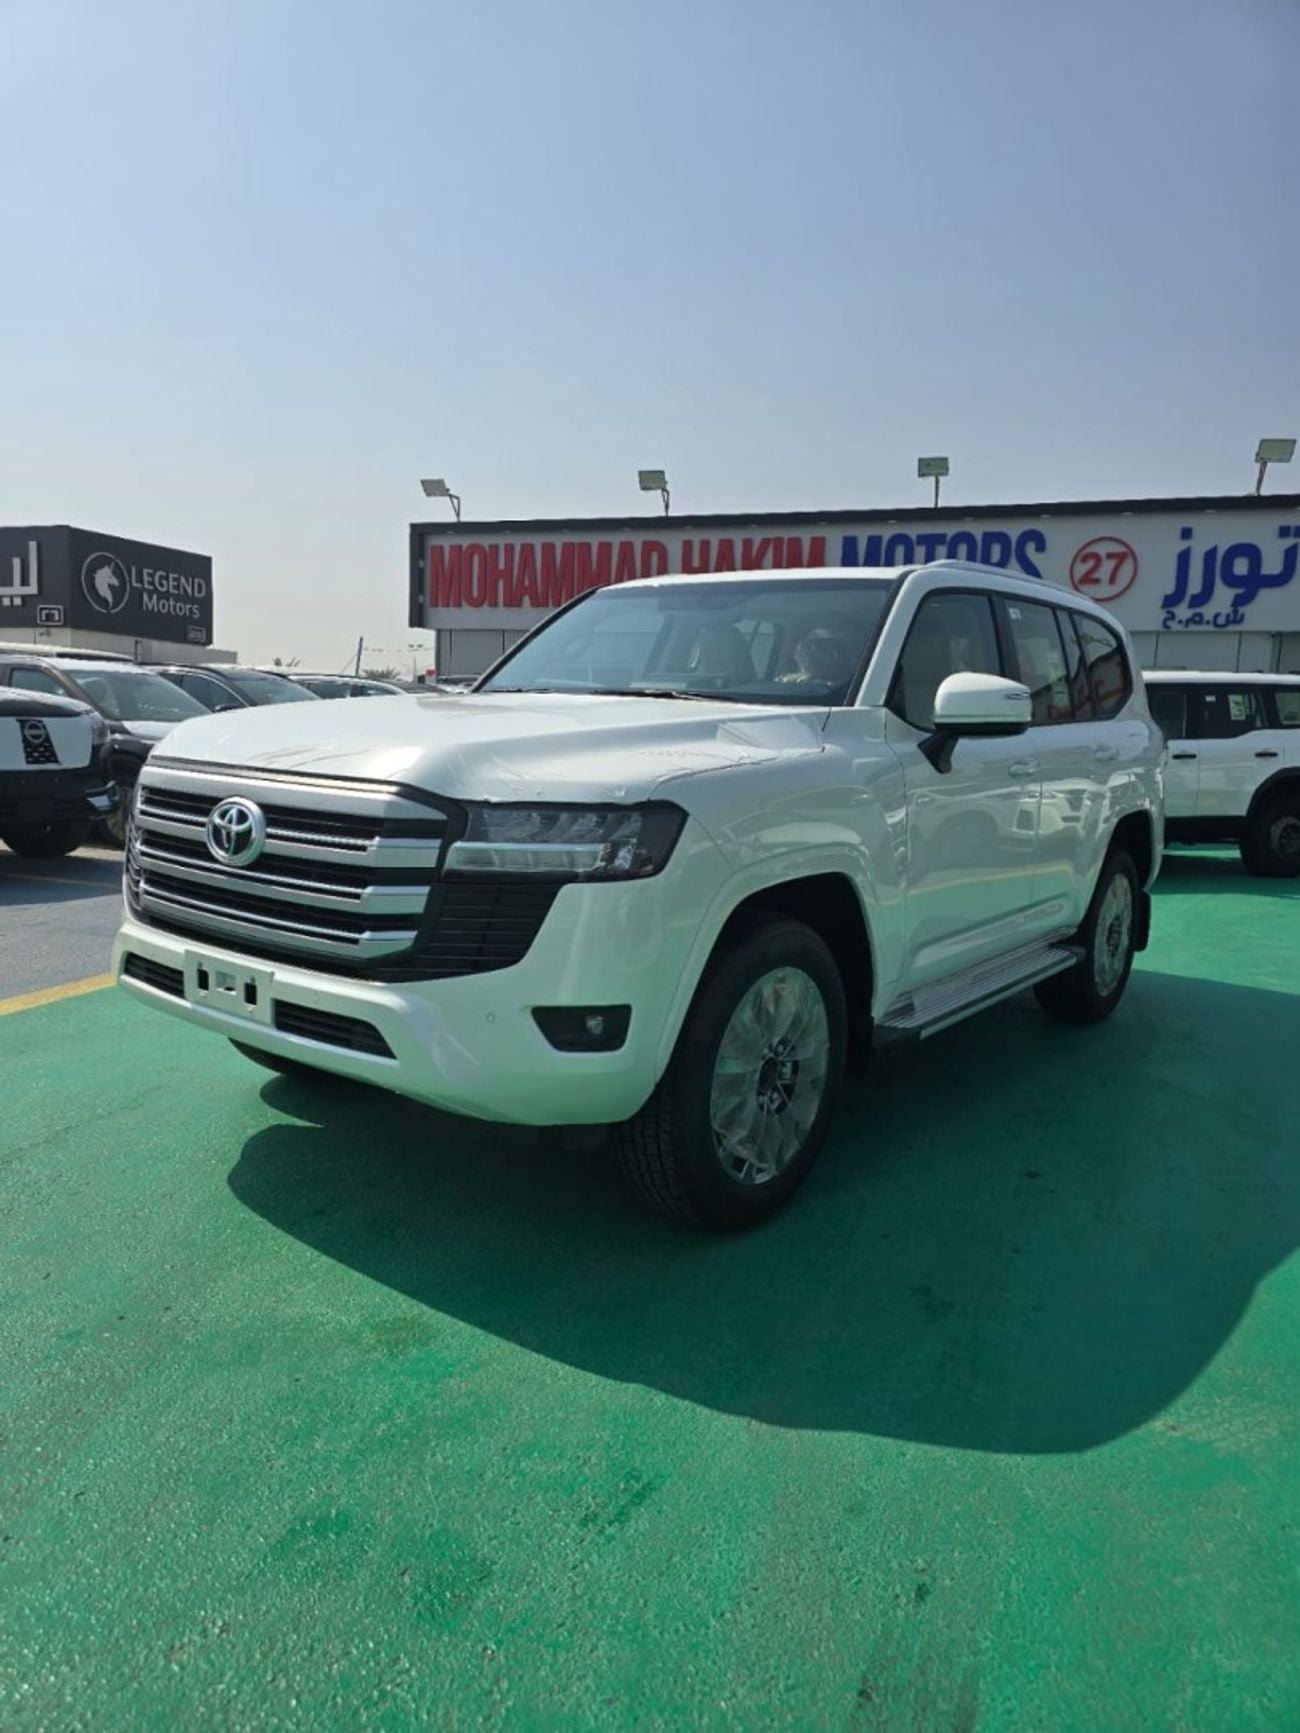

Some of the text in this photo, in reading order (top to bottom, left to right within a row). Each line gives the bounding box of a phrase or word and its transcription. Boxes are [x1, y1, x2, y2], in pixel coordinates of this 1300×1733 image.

[131, 566, 206, 598] LEGEND
[1078, 551, 1129, 585] 27
[143, 592, 200, 619] Motors
